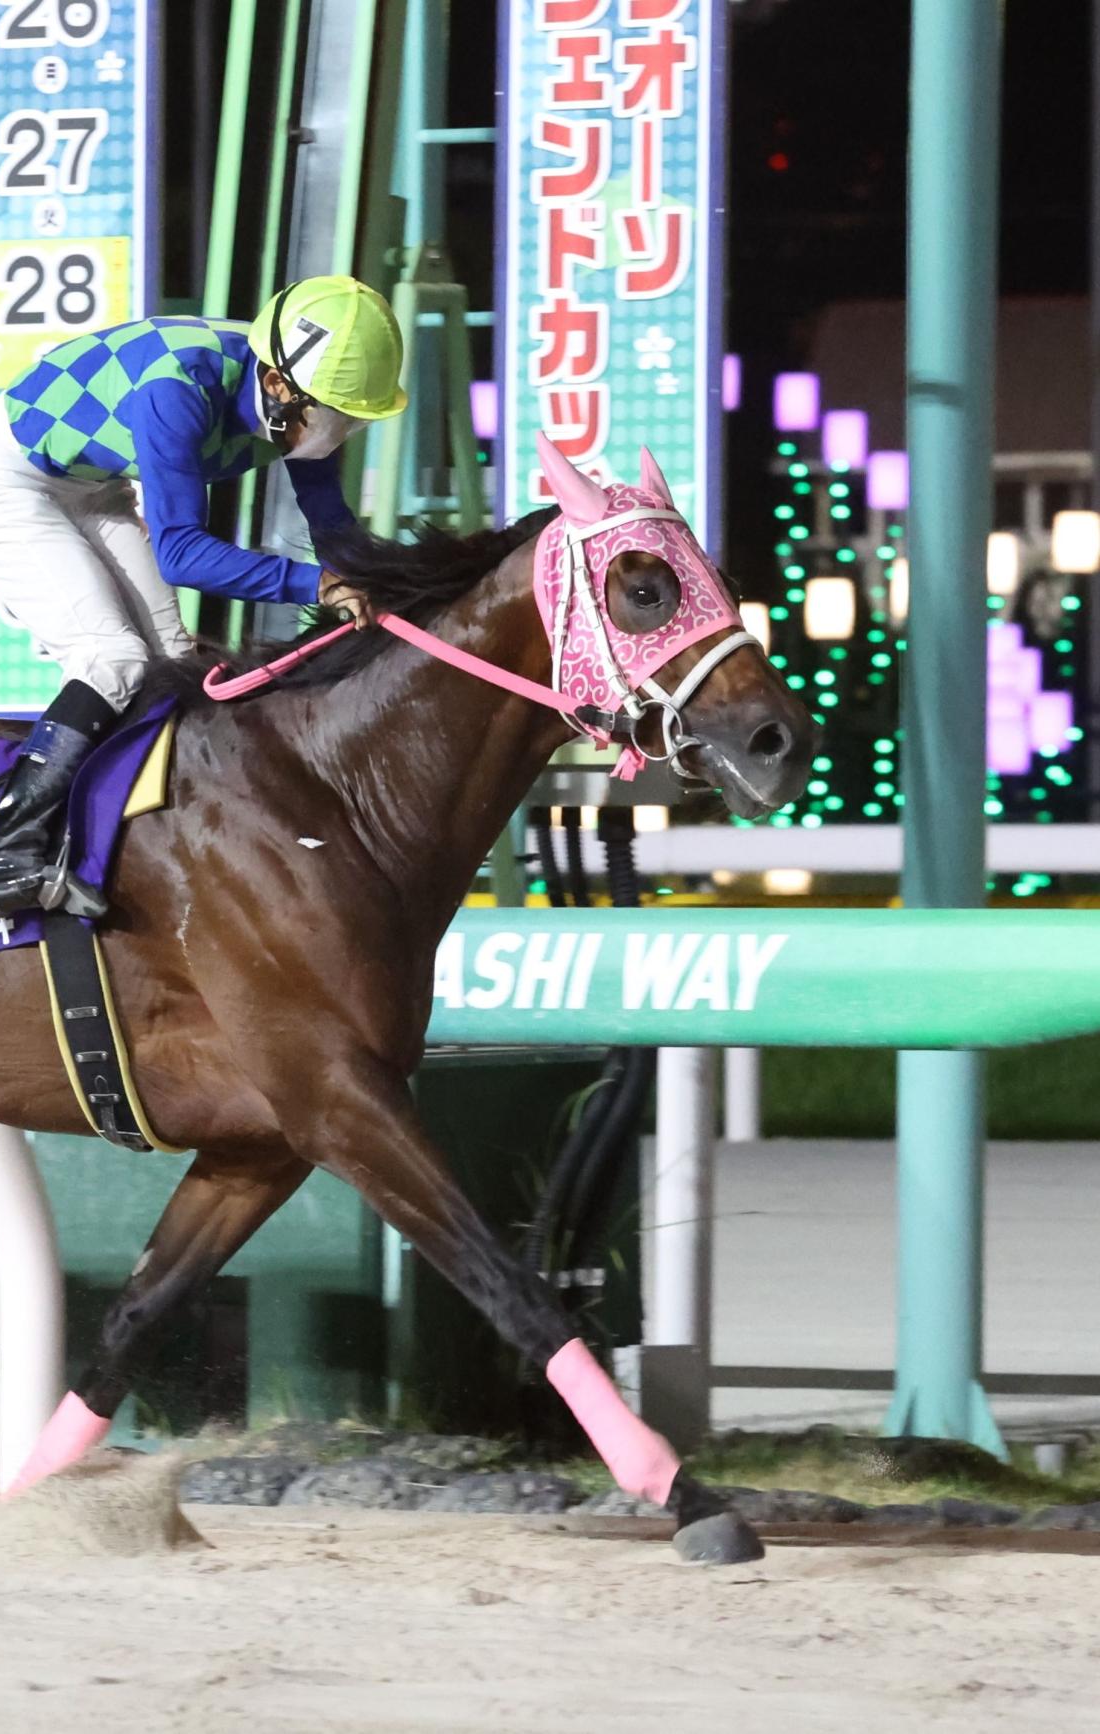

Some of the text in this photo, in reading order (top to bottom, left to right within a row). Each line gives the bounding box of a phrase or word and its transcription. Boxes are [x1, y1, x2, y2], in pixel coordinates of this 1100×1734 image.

[5, 117, 97, 188] 27
[4, 254, 95, 325] 28
[282, 317, 330, 372] 7
[622, 932, 790, 1011] WAY
